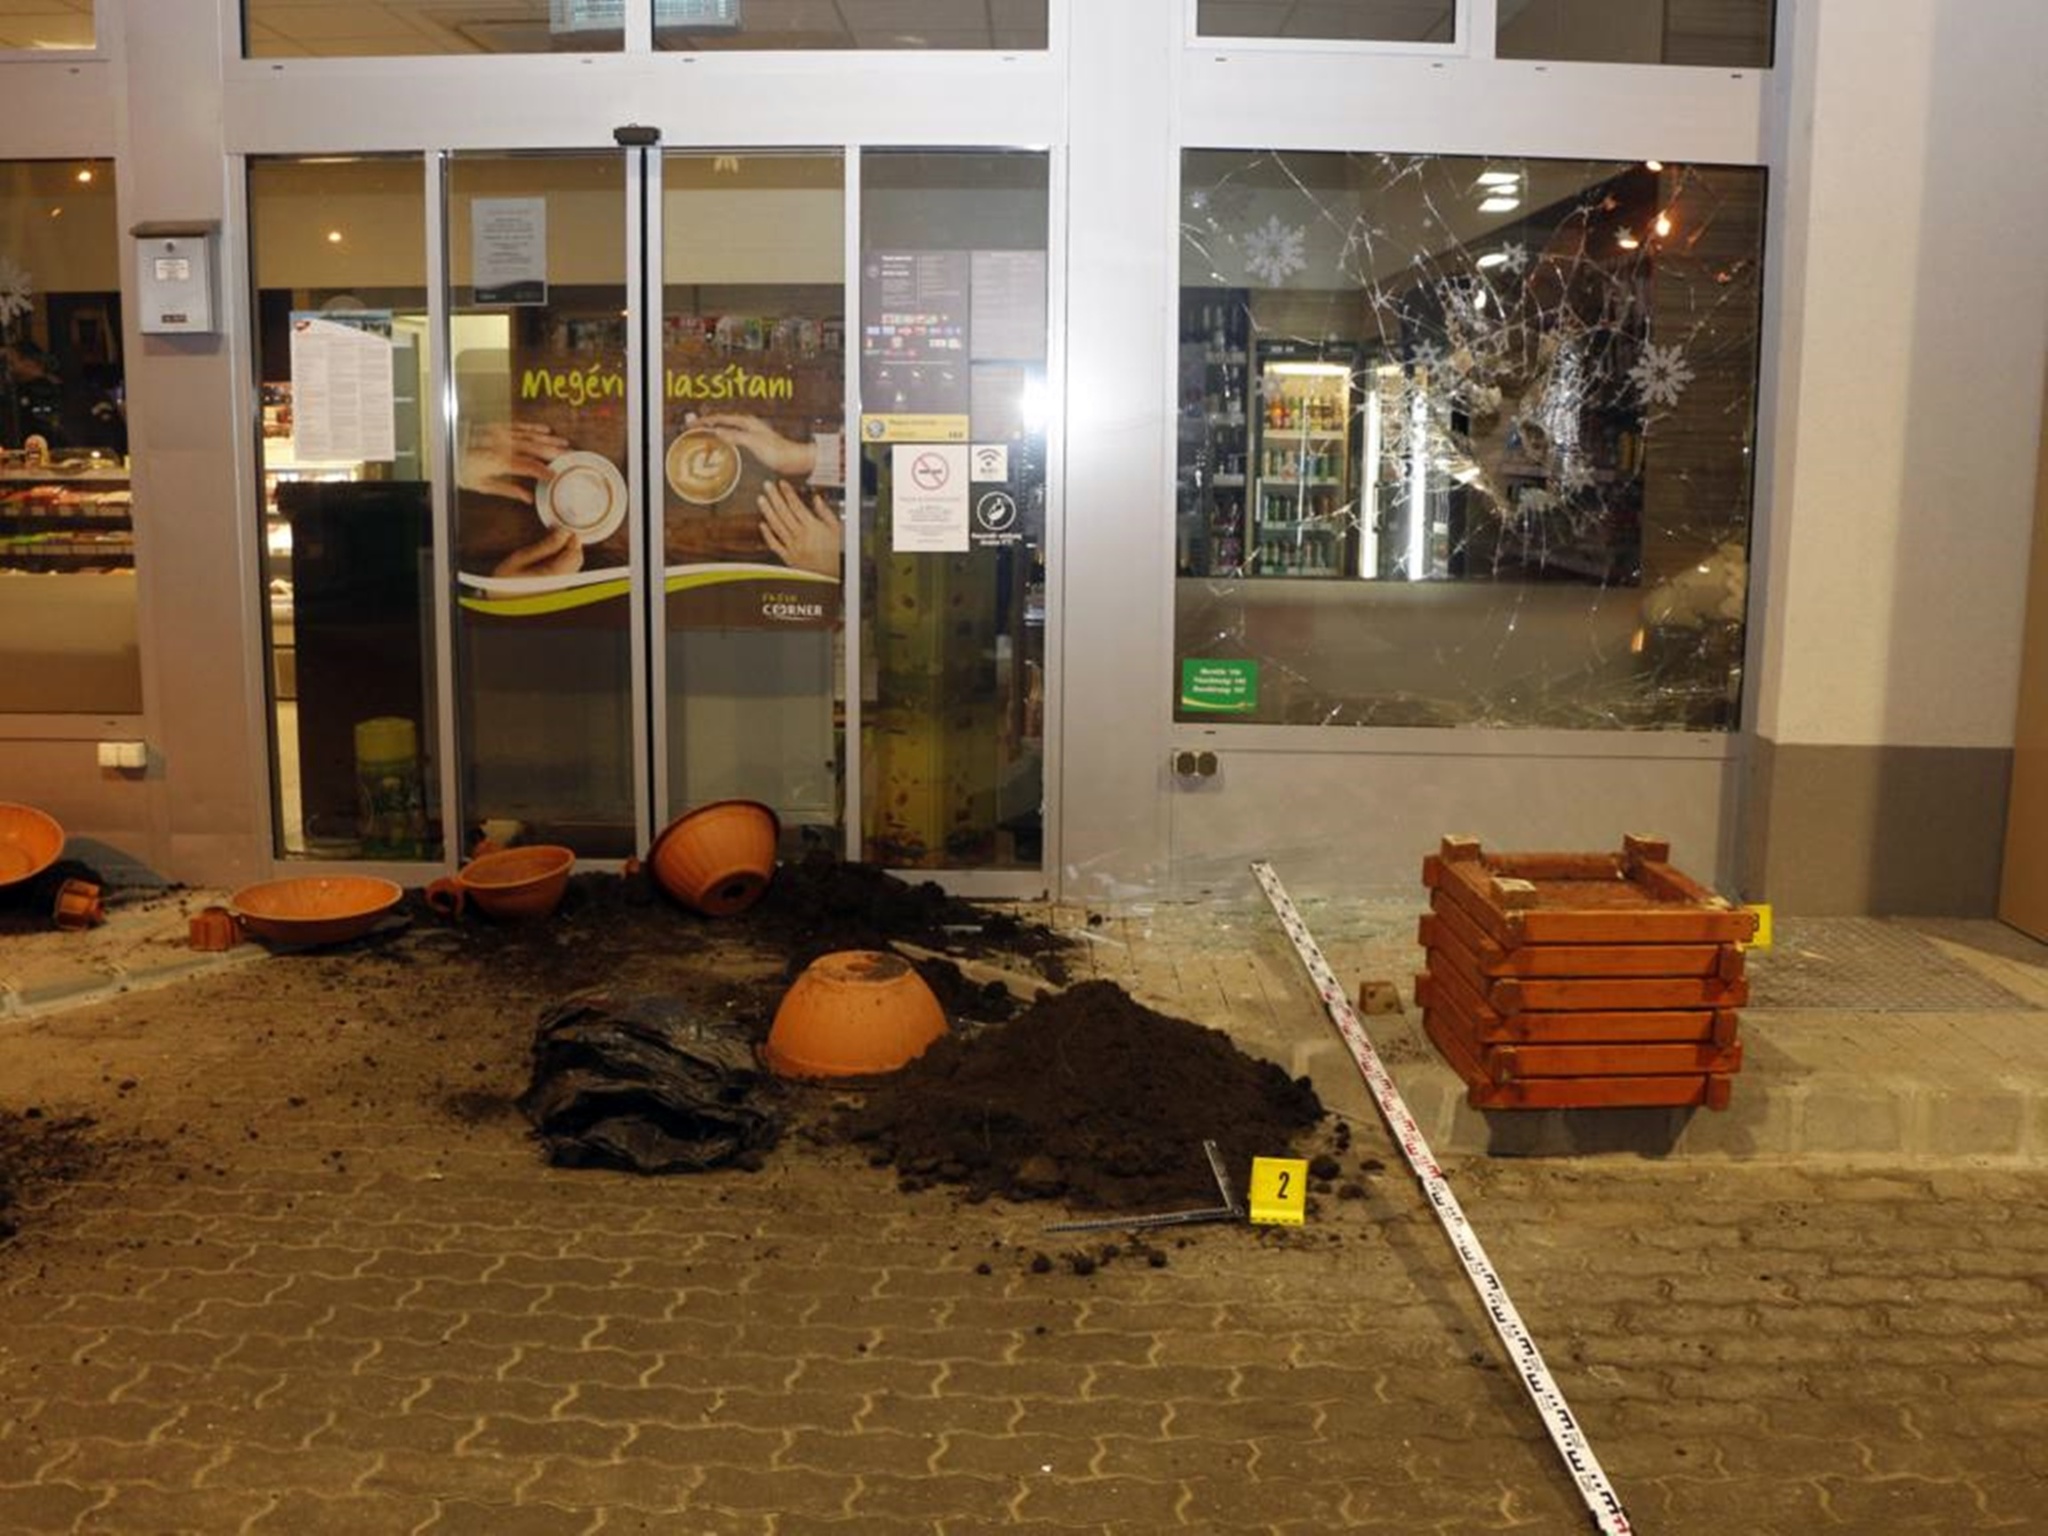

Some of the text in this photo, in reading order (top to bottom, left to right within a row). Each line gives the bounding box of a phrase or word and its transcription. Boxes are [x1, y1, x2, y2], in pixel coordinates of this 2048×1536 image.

[522, 363, 793, 406] Megéri lassítani
[762, 603, 822, 617] CORNER
[1277, 1170, 1290, 1199] 2
